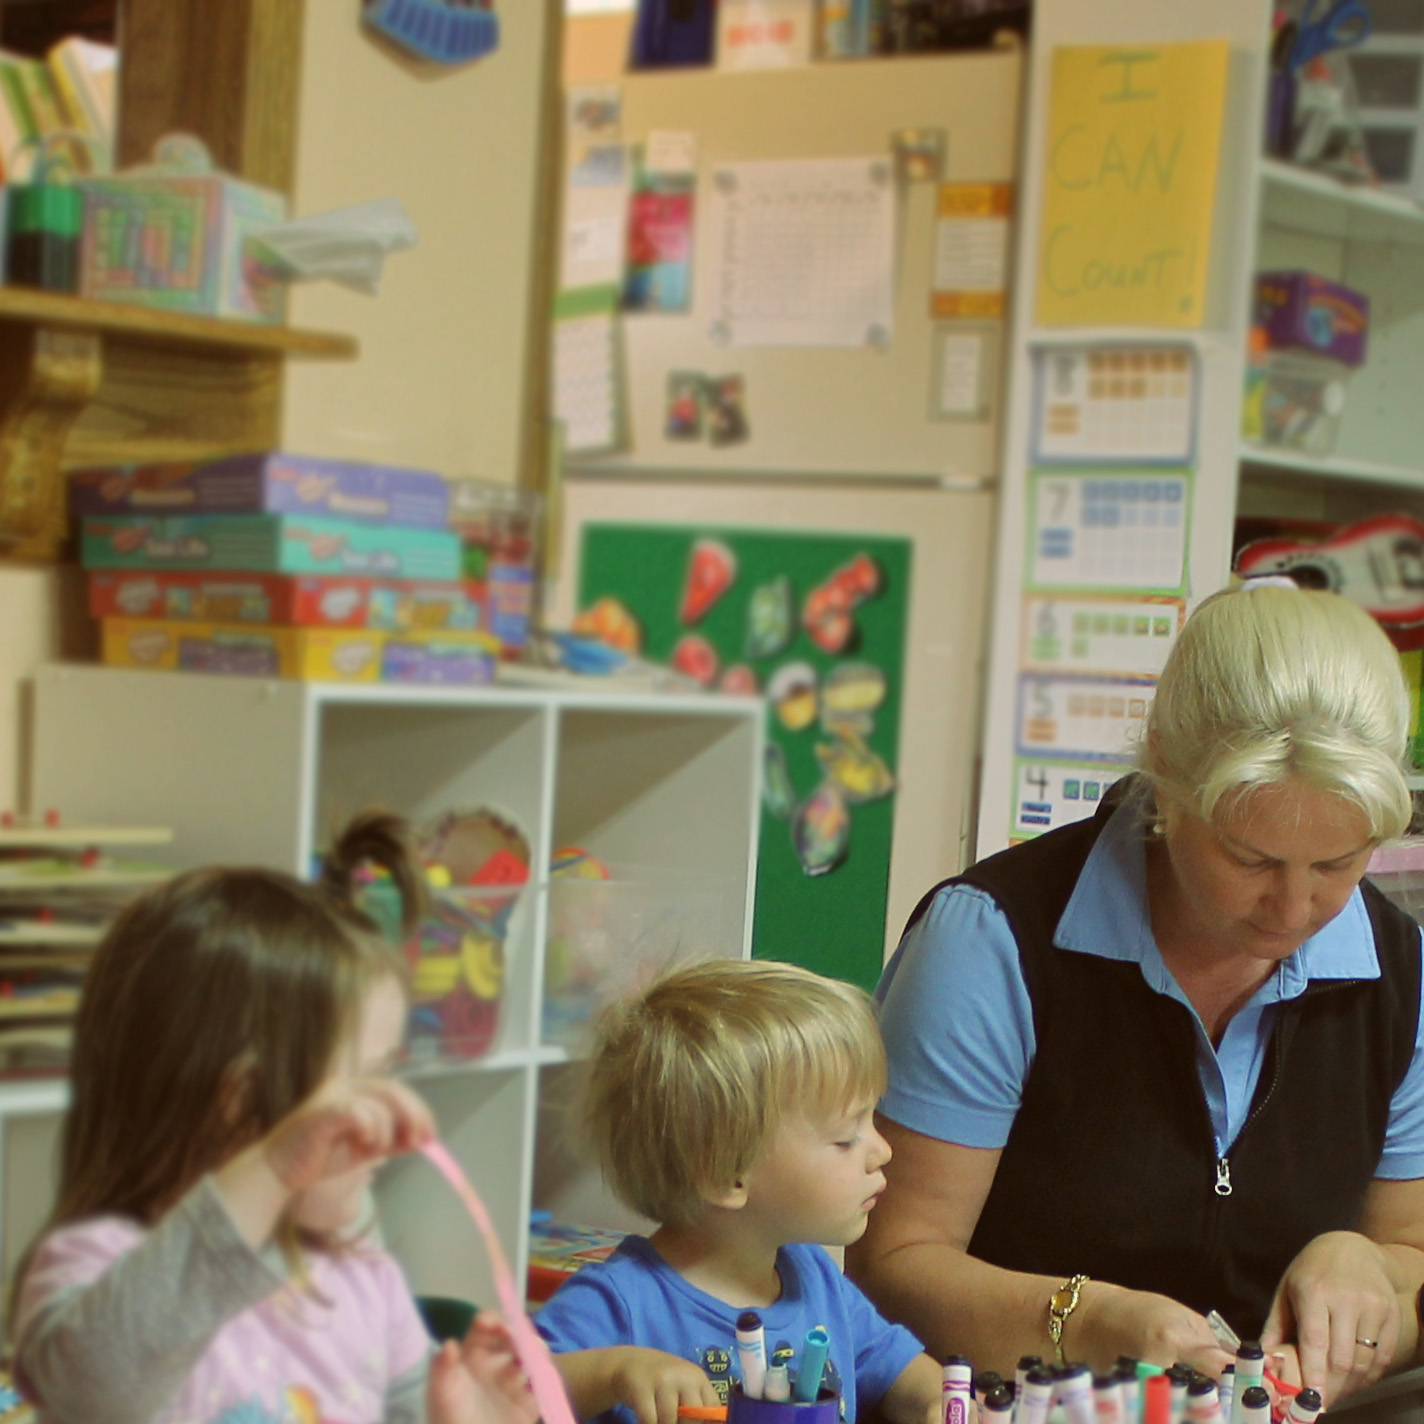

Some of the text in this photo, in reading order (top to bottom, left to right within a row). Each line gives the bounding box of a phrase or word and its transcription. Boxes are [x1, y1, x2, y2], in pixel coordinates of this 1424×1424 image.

[1097, 51, 1163, 104] I
[1051, 123, 1187, 195] CAN
[1046, 482, 1070, 522] 7
[1025, 767, 1050, 801] 4
